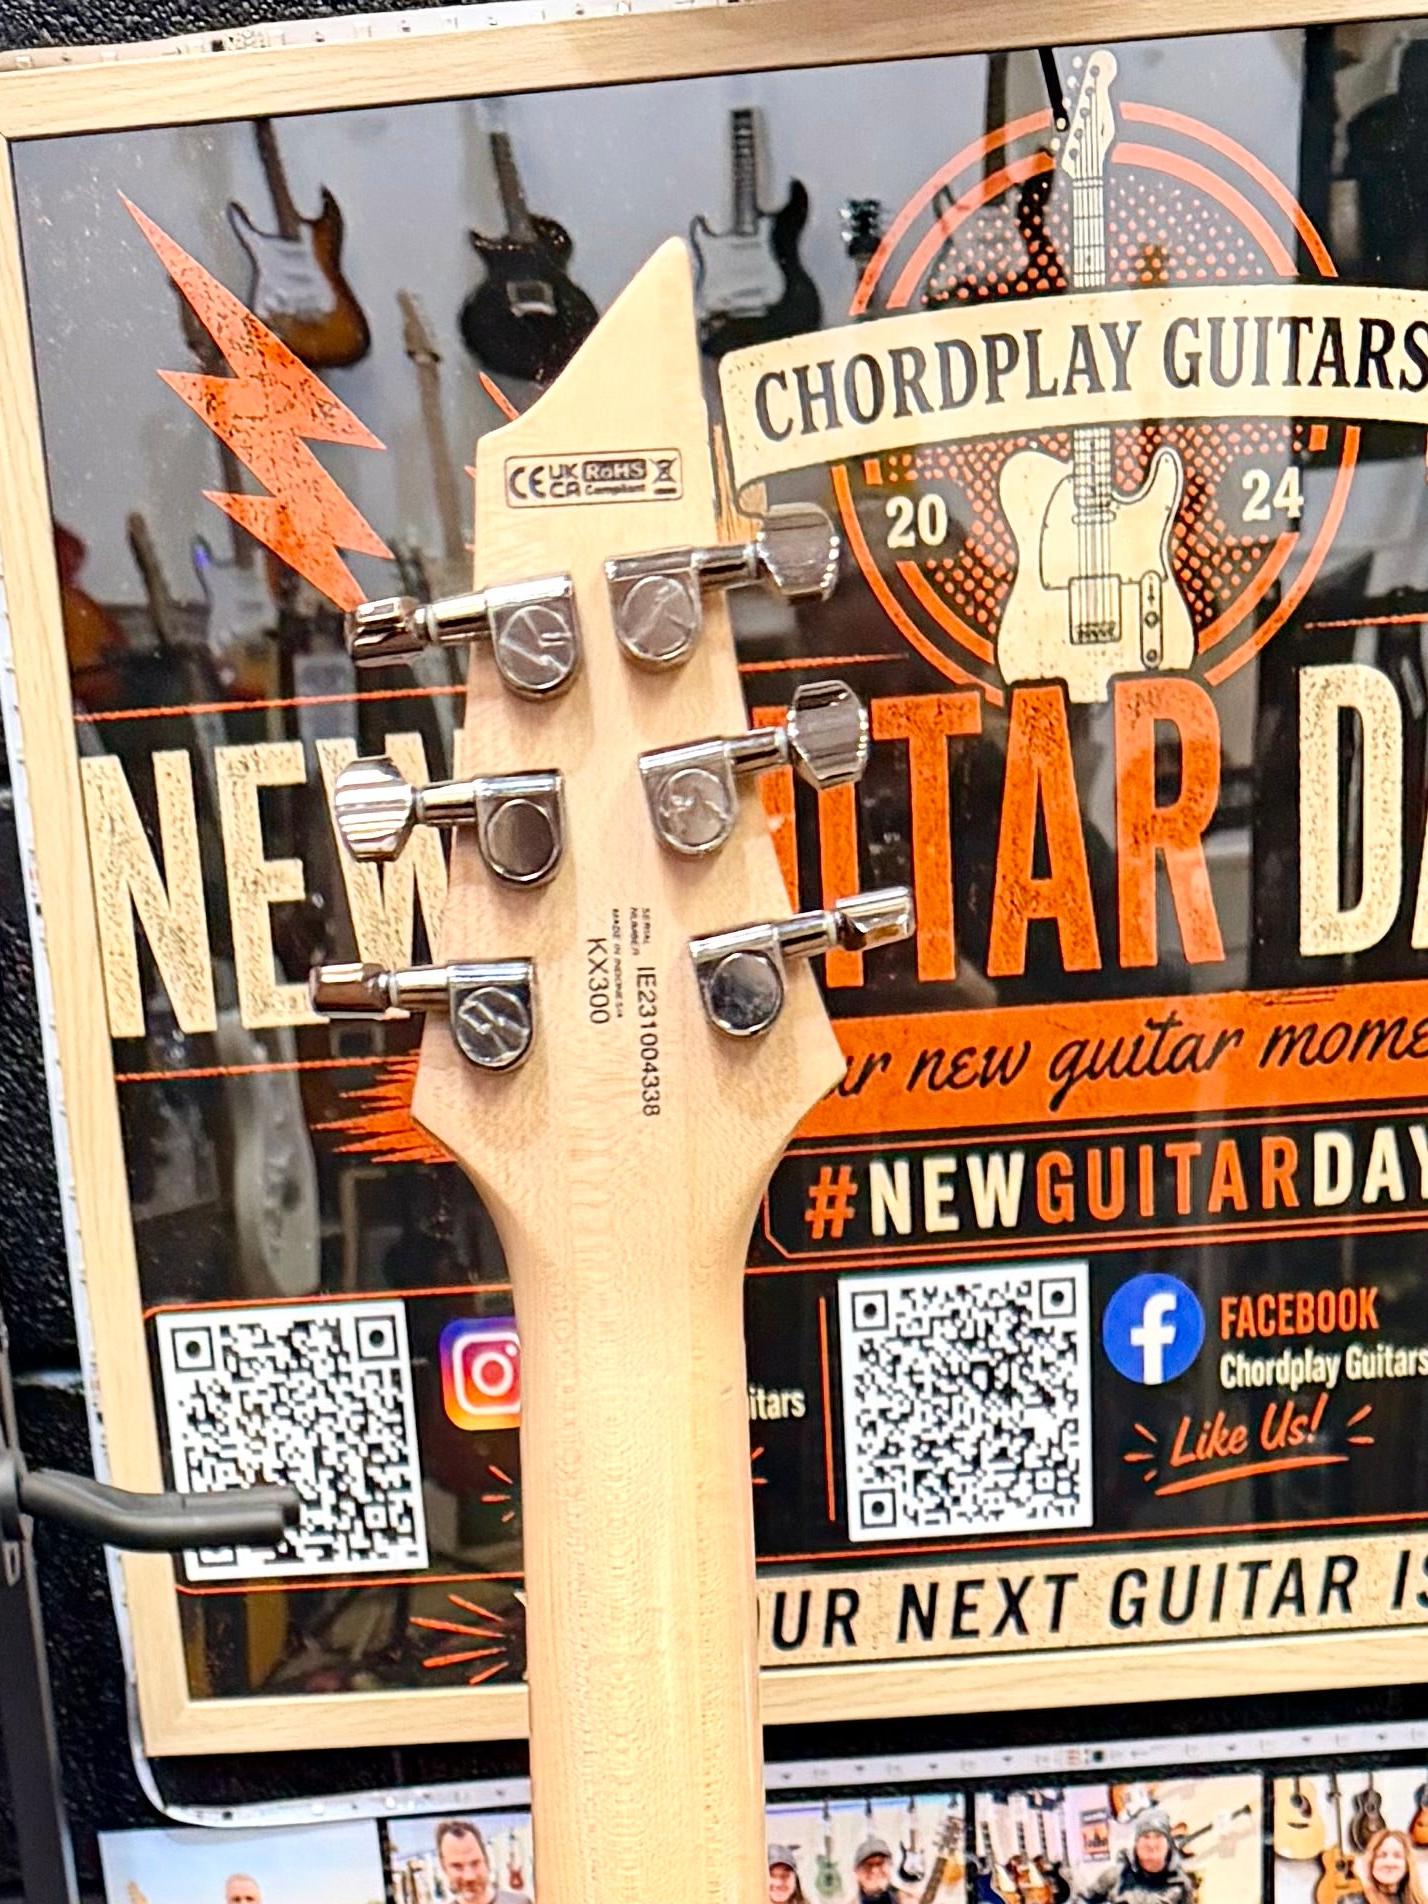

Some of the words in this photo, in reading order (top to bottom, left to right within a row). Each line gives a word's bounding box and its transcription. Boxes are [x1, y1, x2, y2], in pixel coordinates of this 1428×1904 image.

[755, 320, 1142, 442] CHORDPLAY
[549, 462, 578, 480] UK
[585, 462, 645, 481] RoHS
[885, 493, 948, 549] 20
[1242, 469, 1304, 523] 24
[81, 729, 462, 1038] NEW
[753, 678, 1226, 989] ITAR
[586, 937, 611, 1024] KX300
[636, 966, 661, 1117] IE231004338
[834, 1051, 892, 1098] ur
[906, 1040, 1031, 1093] new
[1049, 1011, 1244, 1111] guitar
[1220, 1286, 1380, 1341] FACEBOOK
[749, 1383, 807, 1421] itars
[1220, 1346, 1341, 1392] Chordplay
[1169, 1410, 1249, 1468] Like
[1260, 1392, 1329, 1451] Us!
[757, 1587, 861, 1652] UR
[896, 1572, 1079, 1644] NEXT
[1109, 1554, 1360, 1631] GUITAR
